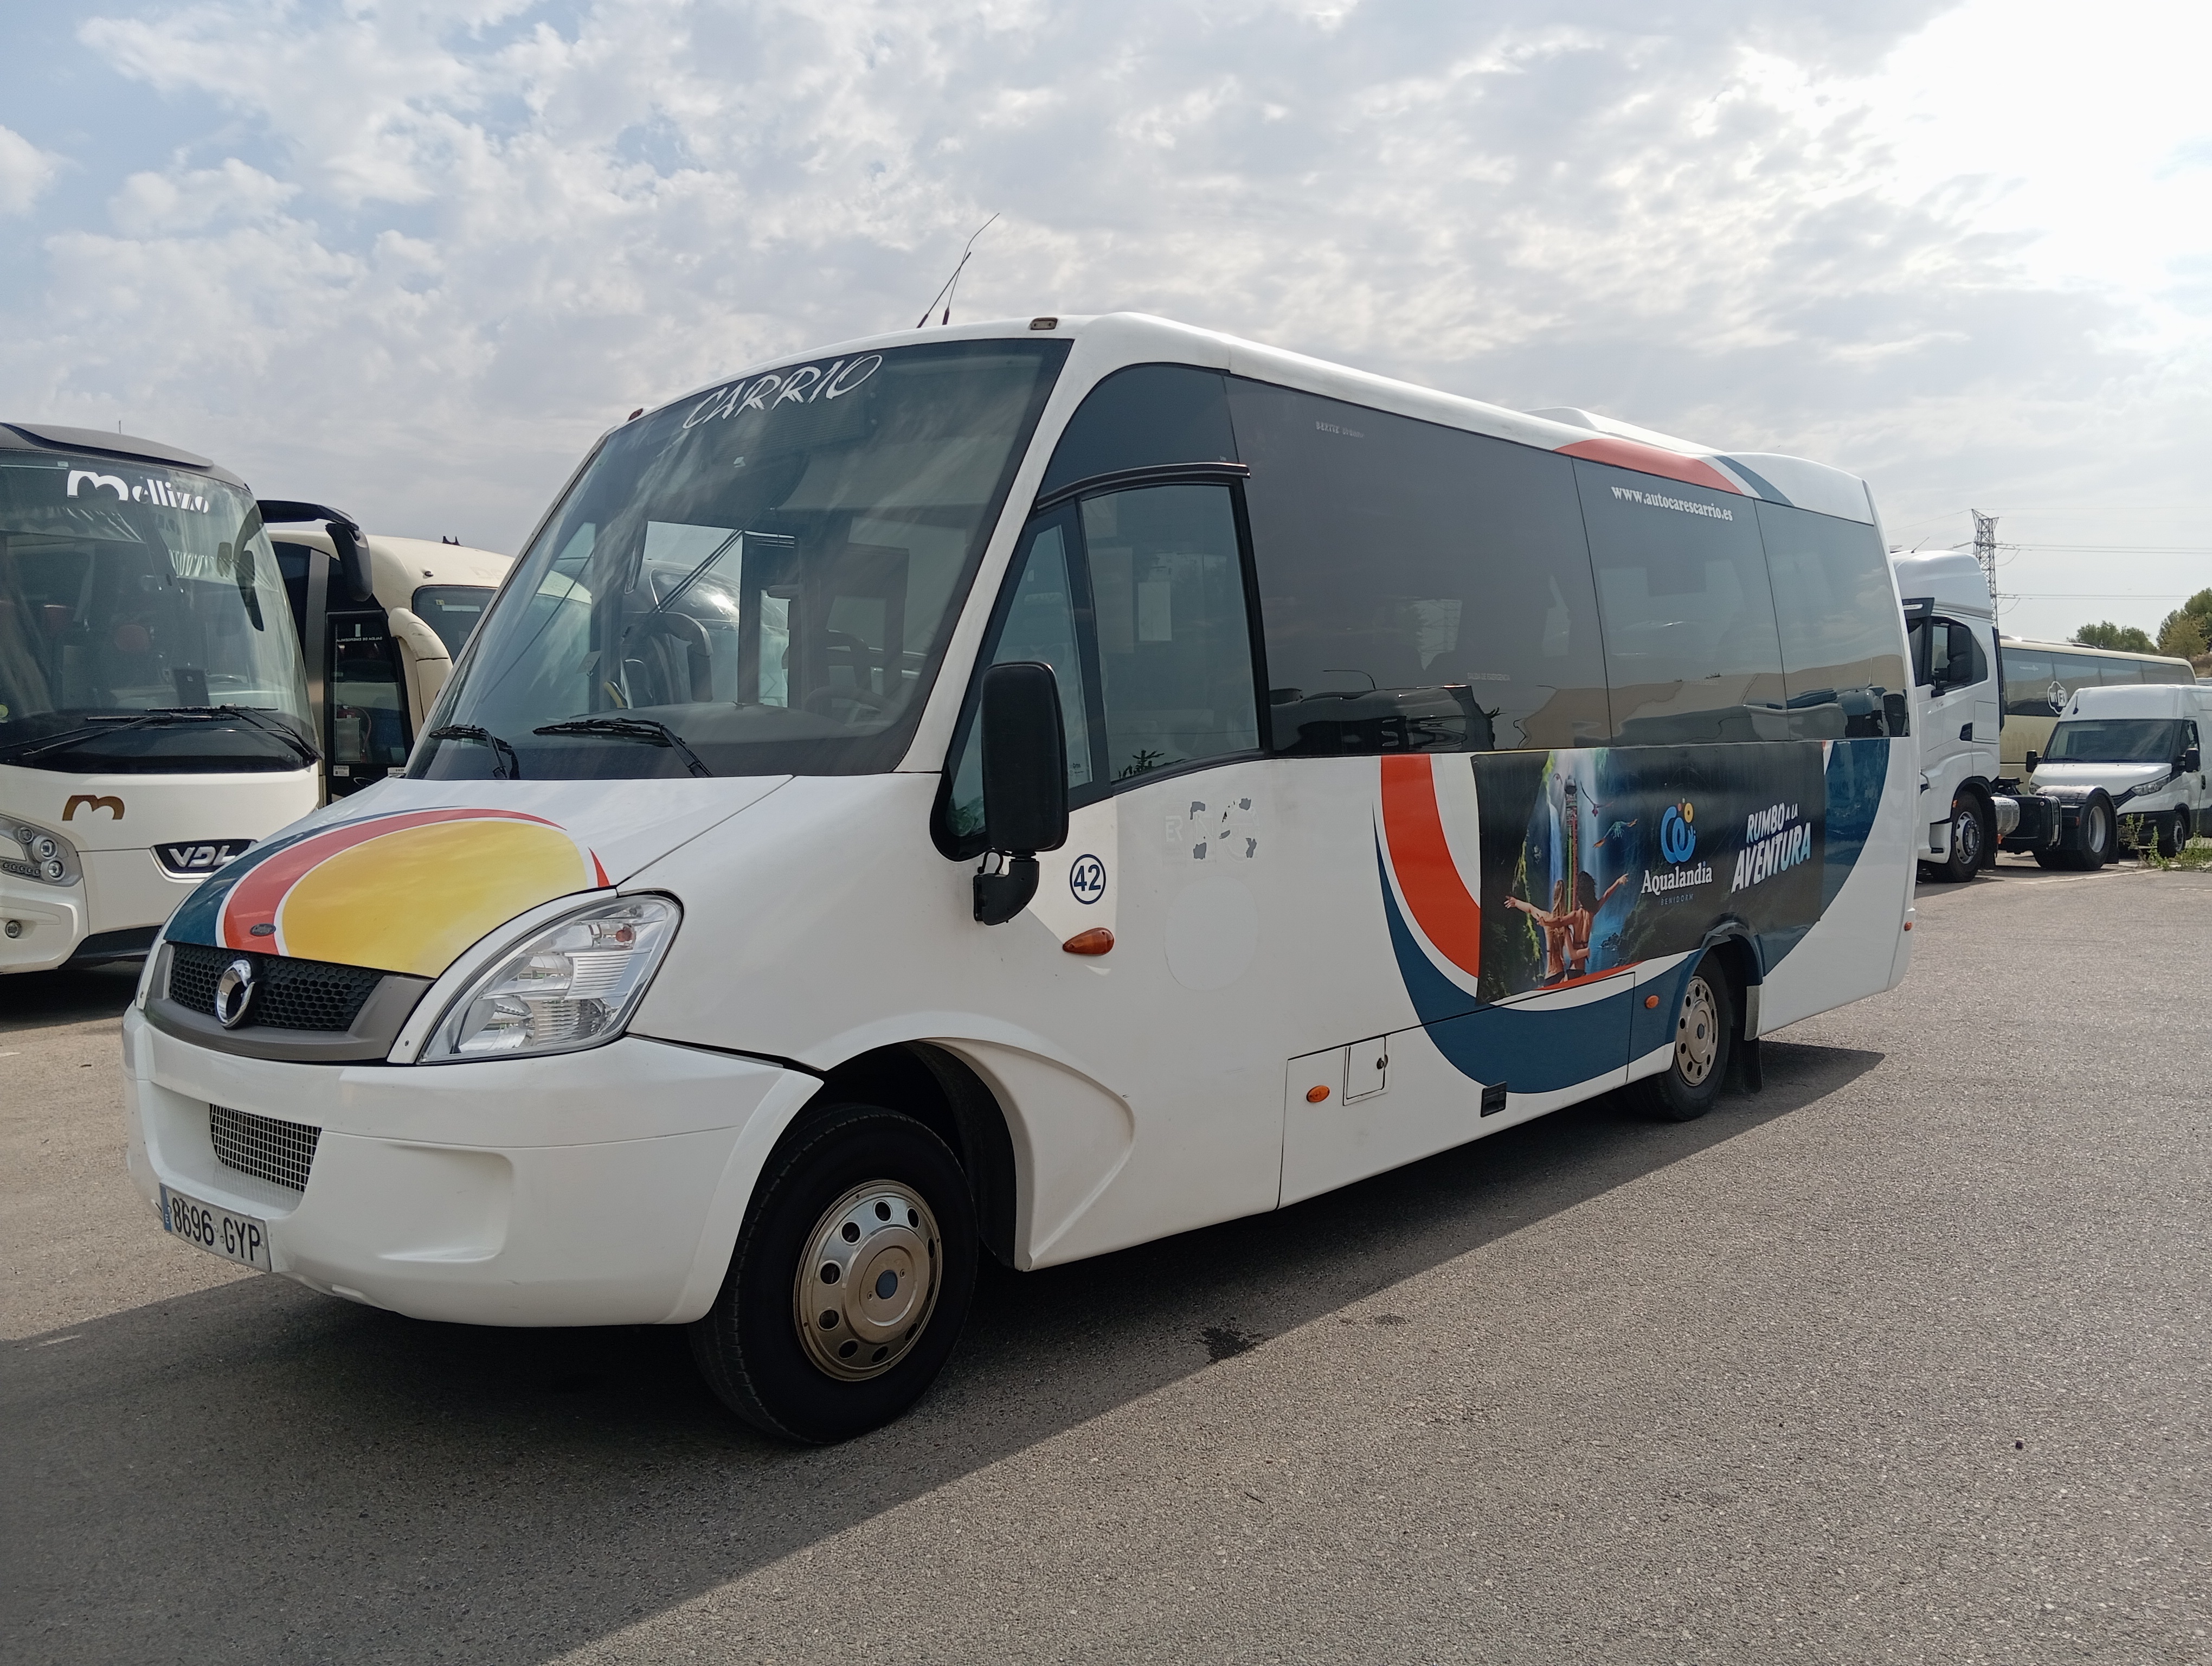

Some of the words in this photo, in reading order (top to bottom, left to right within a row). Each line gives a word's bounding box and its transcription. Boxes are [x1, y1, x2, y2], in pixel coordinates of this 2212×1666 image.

[682, 355, 883, 430] CARRIO
[1611, 486, 1733, 521] www.autocarescarrio.es
[1746, 802, 1785, 844] RUMBO
[1785, 806, 1790, 821] A
[1791, 803, 1798, 820] LA
[168, 845, 236, 868] VDL
[1731, 822, 1811, 894] AVENTURA
[1073, 864, 1101, 892] 42
[1641, 861, 1713, 896] Aqualandia
[1660, 893, 1694, 906] BENIDORM
[172, 1197, 214, 1246] 8696
[223, 1217, 260, 1261] GYP
